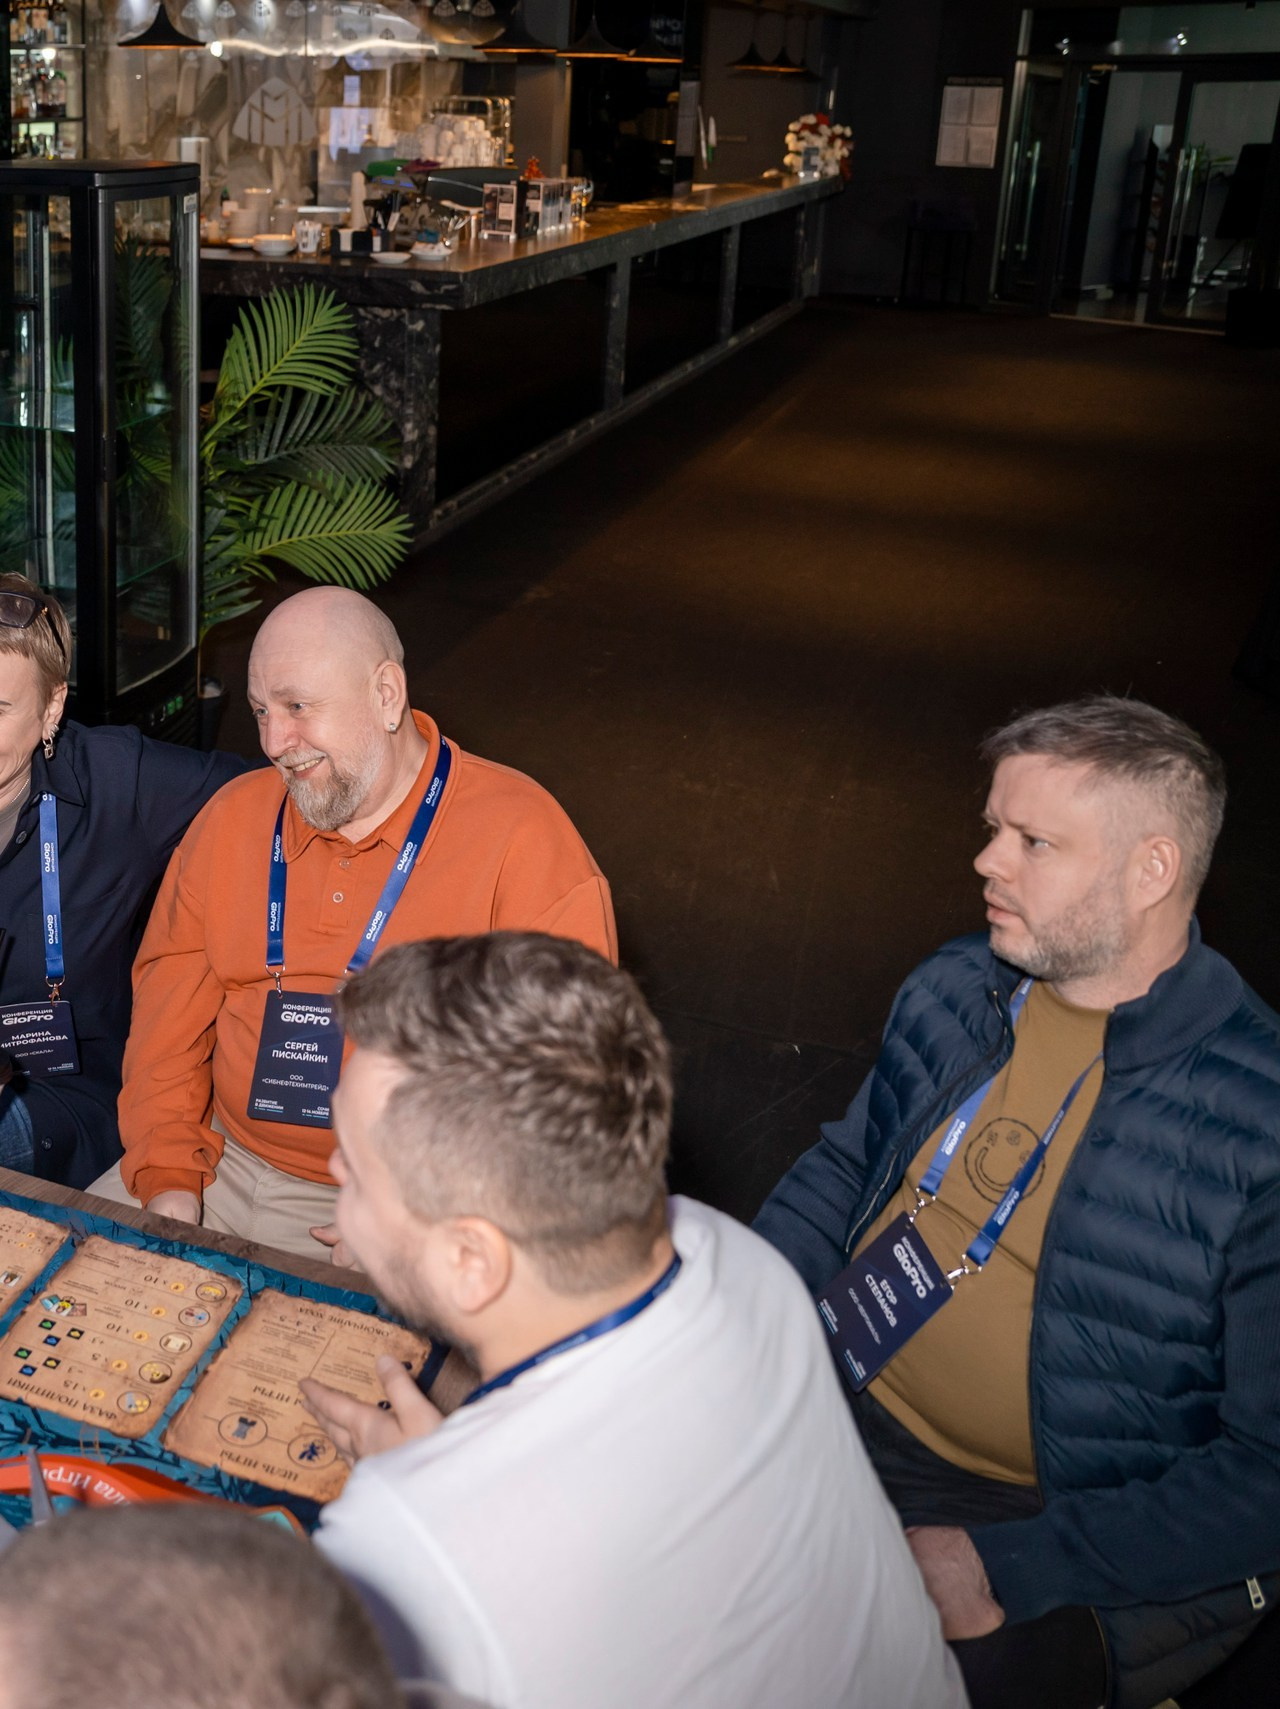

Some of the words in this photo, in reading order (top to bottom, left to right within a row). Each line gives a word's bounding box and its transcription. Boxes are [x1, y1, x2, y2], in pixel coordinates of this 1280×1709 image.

[425, 776, 440, 804] GloPro
[397, 841, 414, 871] GloPro
[270, 902, 278, 931] GloPro
[366, 910, 383, 940] GloPro
[2, 1009, 53, 1019] КОНФЕРЕНЦИЯ
[282, 1003, 332, 1014] КОНФЕРЕНЦИЯ
[2, 1014, 54, 1025] GloPro
[281, 1011, 330, 1026] GloPro
[11, 1030, 51, 1041] МАРИНА
[284, 1041, 318, 1052] СЕРГЕЙ
[272, 1050, 328, 1063] ПИСКАЙКИН
[144, 1274, 159, 1284] 10
[892, 1242, 927, 1299] GloPro
[879, 1279, 898, 1305] ЕГОР
[125, 1299, 140, 1309] 10
[864, 1274, 898, 1328] СТЕПАНОВ
[106, 1322, 121, 1333] 10
[7, 1377, 80, 1408] ПОЛИТИКИ
[252, 1385, 291, 1402] ИГРЫ
[82, 1402, 117, 1420] ФАЗА
[220, 1449, 259, 1468] ИГРЫ
[261, 1462, 299, 1482] ЦЕЛЬ
